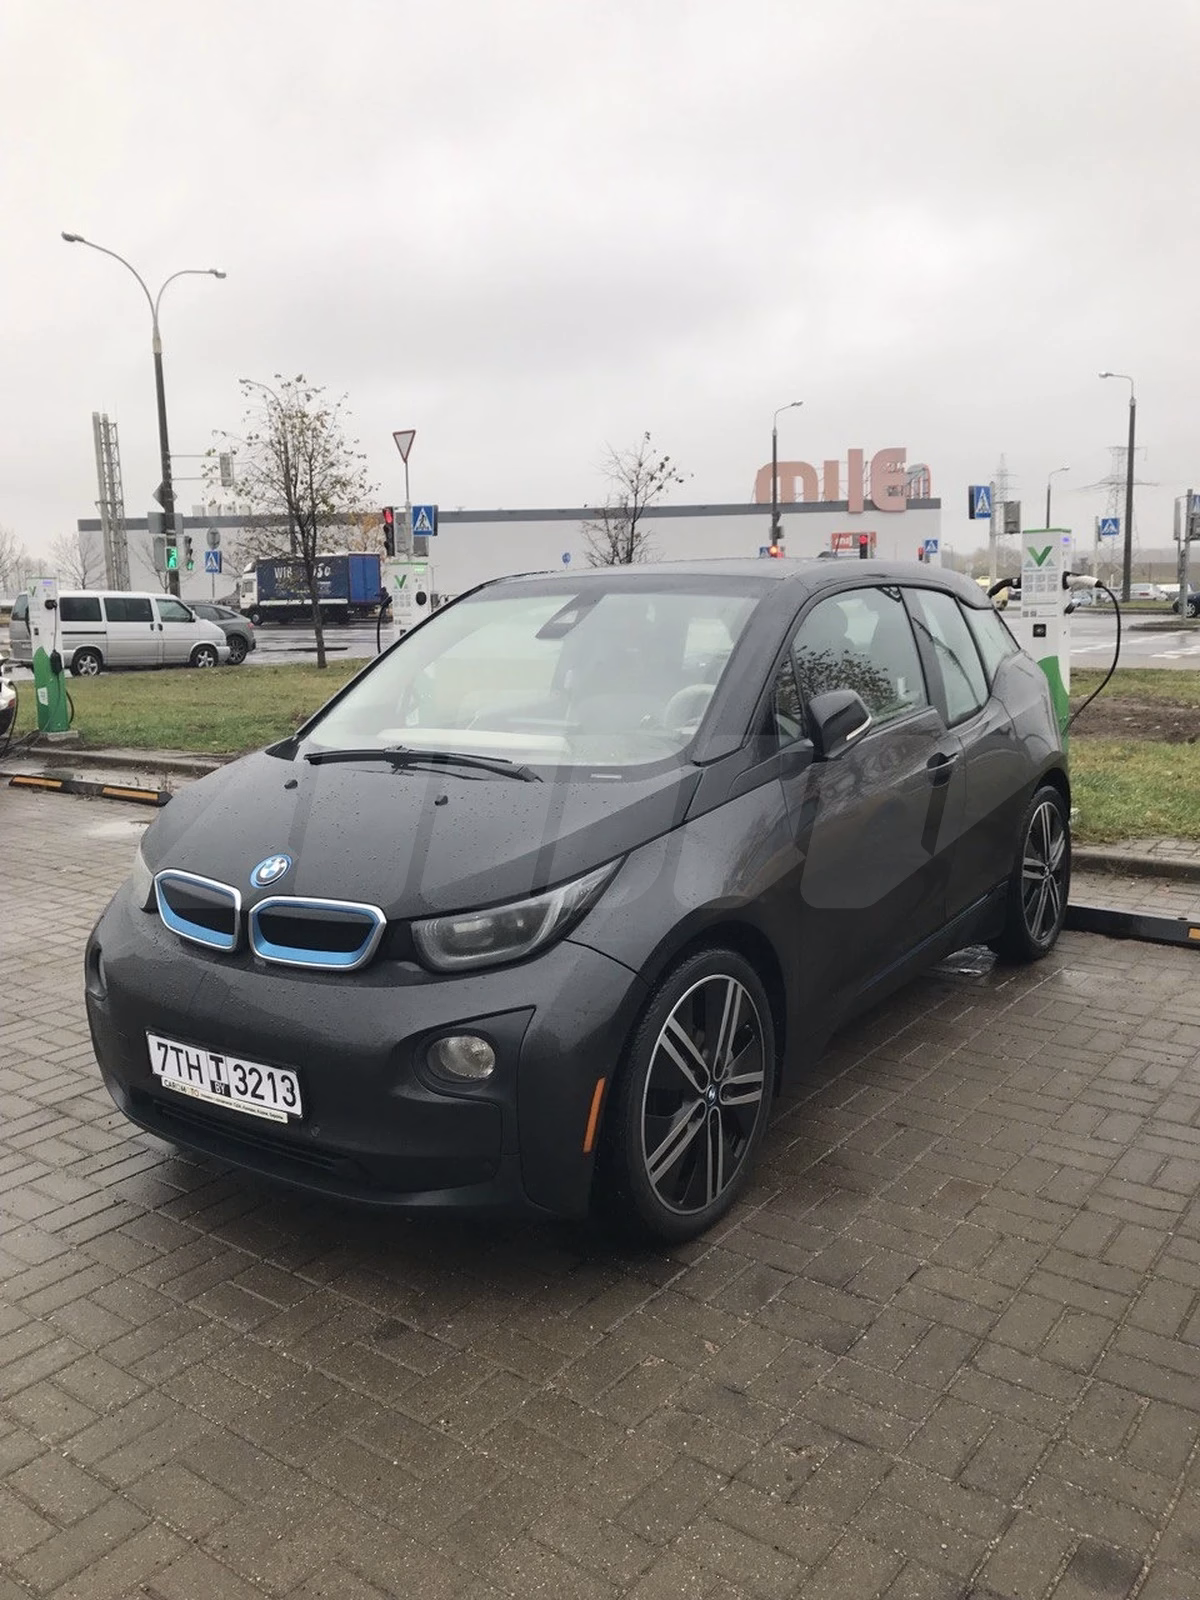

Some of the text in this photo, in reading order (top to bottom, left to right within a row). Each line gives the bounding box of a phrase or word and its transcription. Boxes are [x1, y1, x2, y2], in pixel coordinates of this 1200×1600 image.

[156, 1041, 203, 1084] 7TH
[209, 1055, 224, 1082] T
[233, 1063, 297, 1107] 3213
